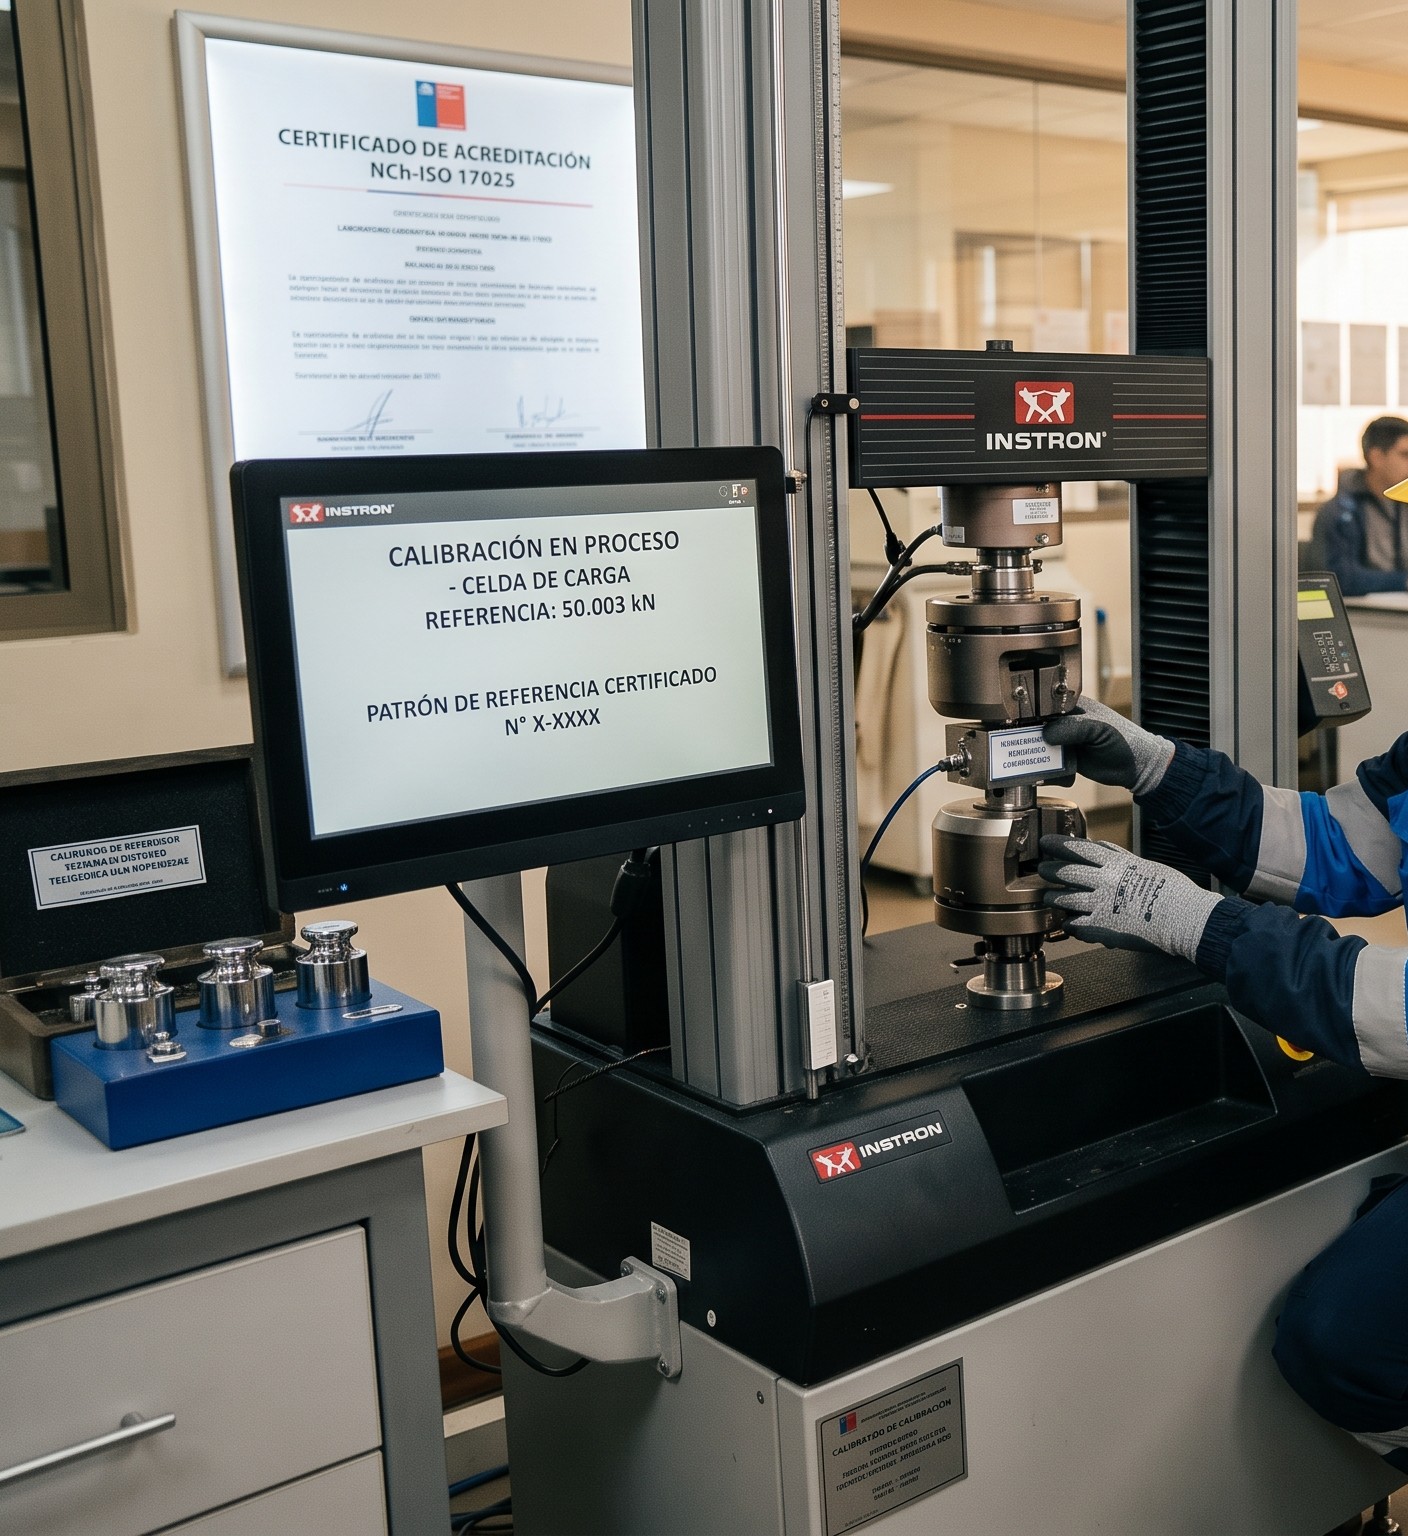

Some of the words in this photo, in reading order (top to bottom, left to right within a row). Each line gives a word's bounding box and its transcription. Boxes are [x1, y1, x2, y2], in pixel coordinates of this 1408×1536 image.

[279, 129, 417, 155] CERTIFICADO
[423, 141, 448, 159] DE
[454, 144, 591, 169] ACREDITACIÓN
[370, 162, 451, 183] NCh-ISO
[459, 170, 515, 187] 17025
[389, 535, 542, 567] CALIBRACIÓN
[550, 536, 577, 557] EN
[585, 530, 679, 554] PROCESO
[462, 573, 527, 595] CELDA
[533, 571, 558, 590] DE
[564, 565, 631, 587] CARGA
[426, 602, 556, 630] REFERENCIA:
[563, 596, 625, 618] 50.003
[632, 593, 655, 612] kN
[367, 693, 448, 722] PATRÓN
[455, 693, 480, 713] DE
[486, 679, 599, 708] REFERENCIA
[604, 666, 717, 694] CERTIFICADO
[532, 708, 601, 733] X-XXXX
[110, 844, 122, 853] DE
[859, 1122, 943, 1158] INSTRON
[887, 1422, 898, 1433] DE
